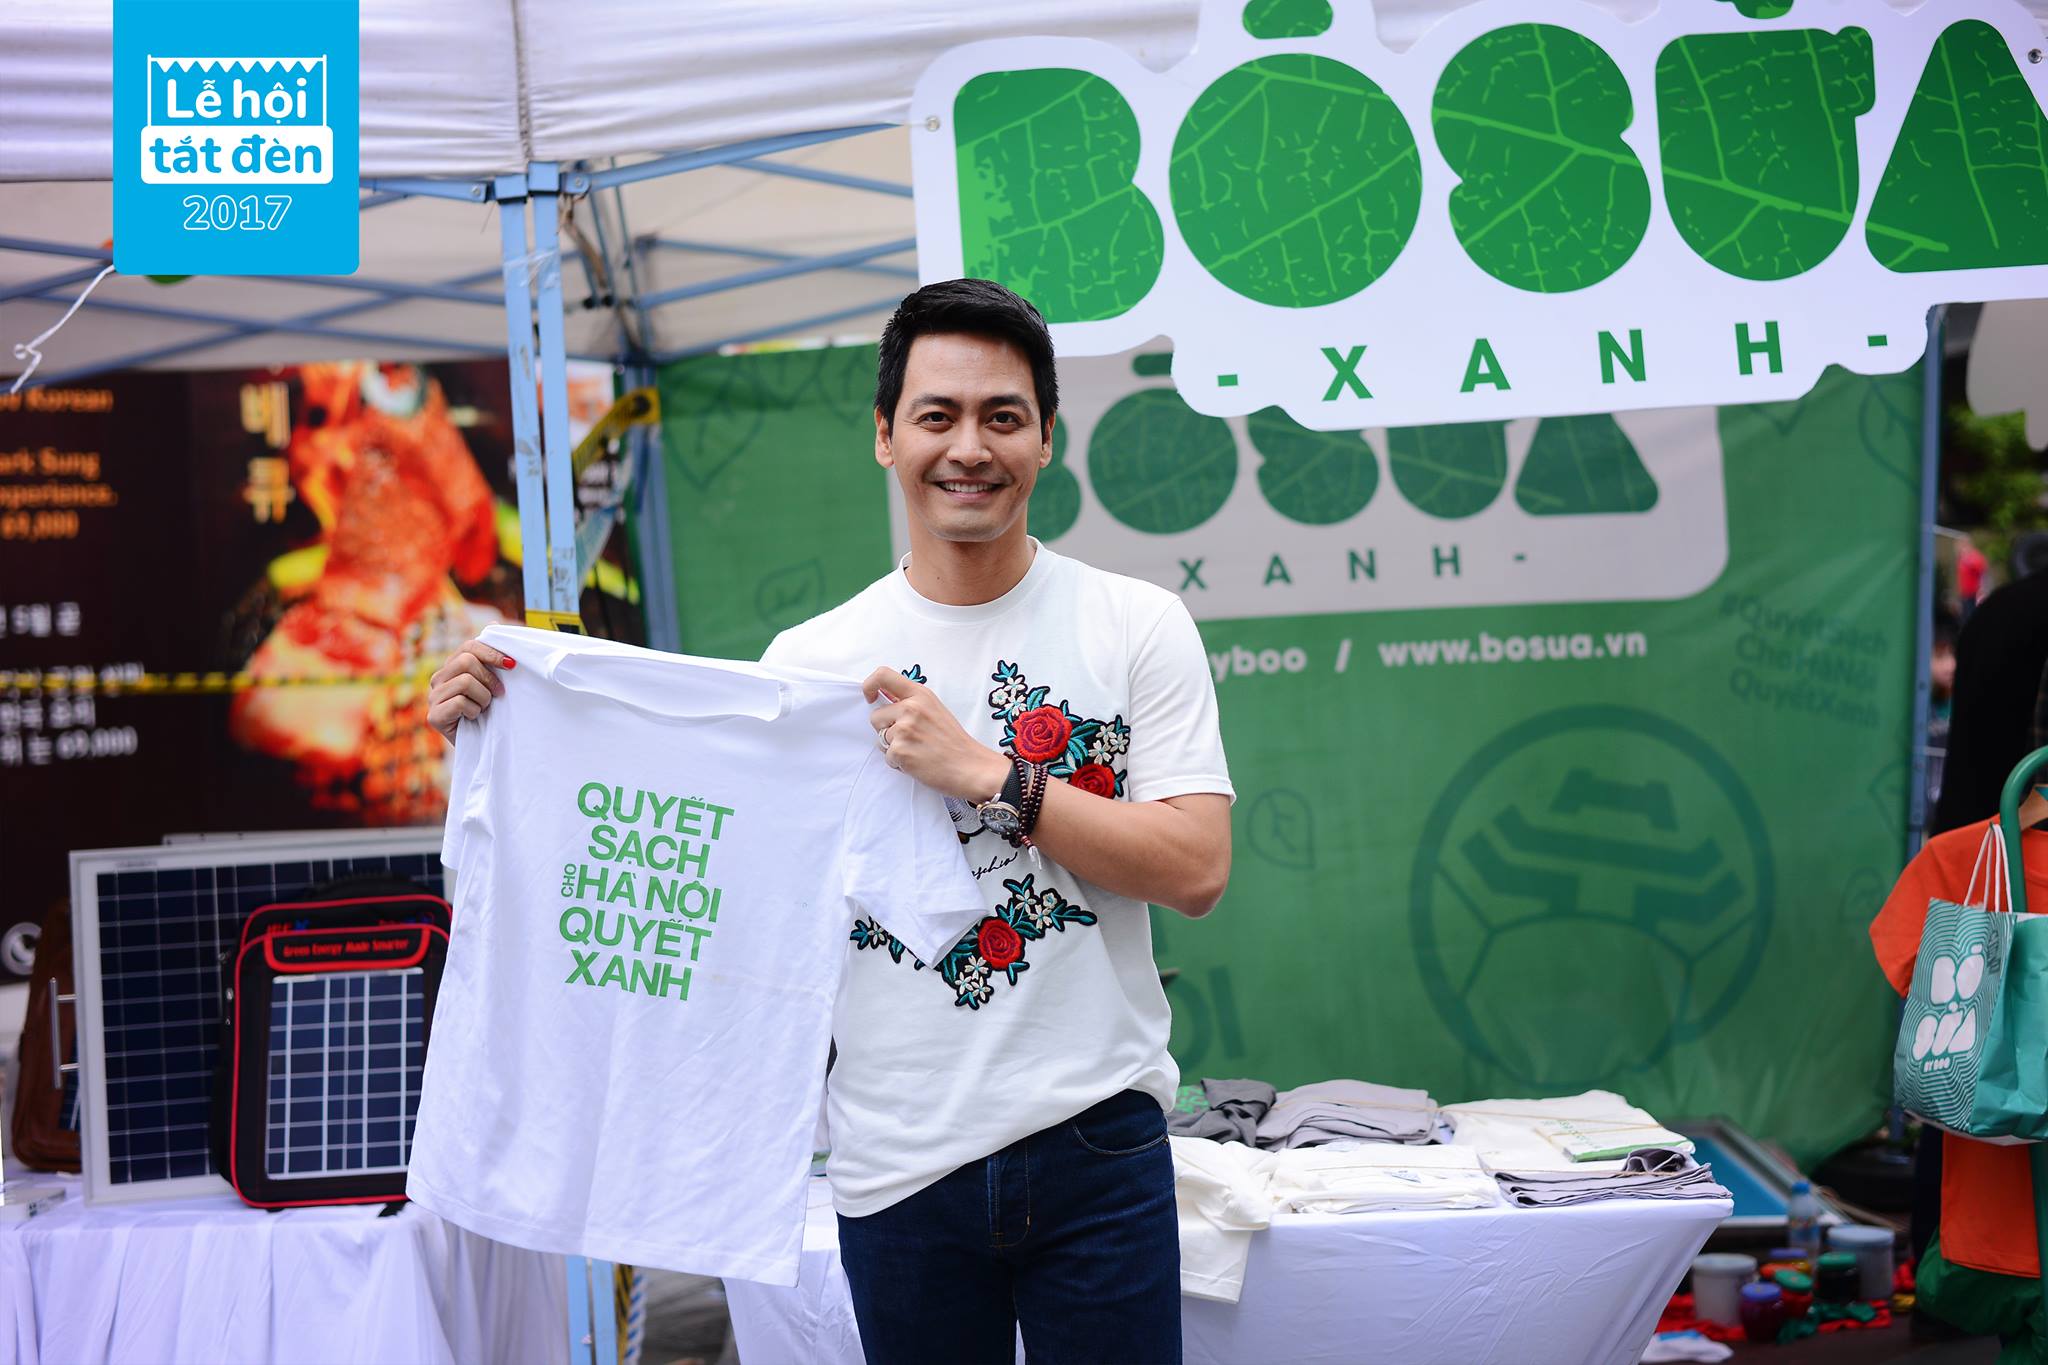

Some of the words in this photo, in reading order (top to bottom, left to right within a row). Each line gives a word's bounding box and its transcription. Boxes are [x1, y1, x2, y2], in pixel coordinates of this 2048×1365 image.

[1378, 631, 1648, 667] www.bosua.vn
[577, 781, 735, 841] QUYẾT
[588, 824, 711, 879] SẠCH
[560, 863, 577, 898] CHO
[576, 864, 637, 908] HÀ
[645, 875, 722, 923] NỘI
[559, 906, 712, 962] QUYẾT
[564, 949, 693, 1001] XANH
